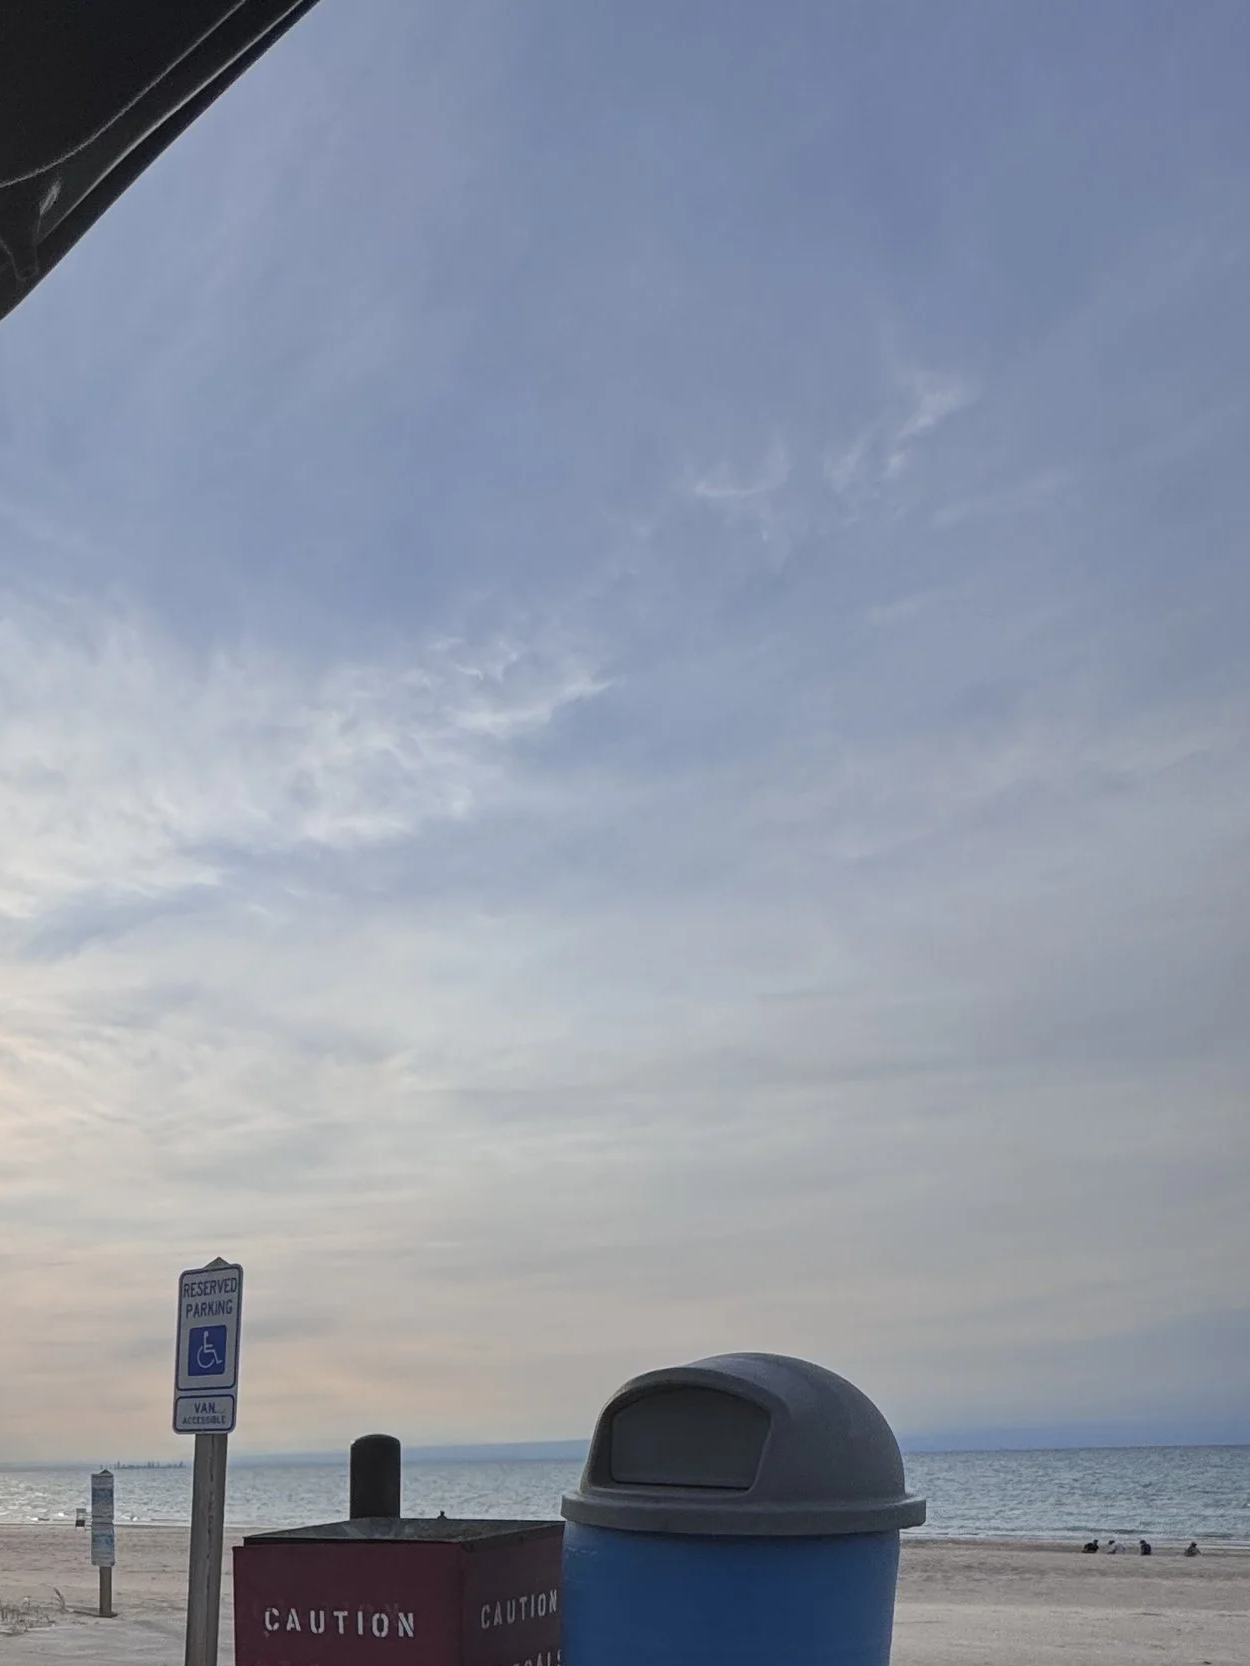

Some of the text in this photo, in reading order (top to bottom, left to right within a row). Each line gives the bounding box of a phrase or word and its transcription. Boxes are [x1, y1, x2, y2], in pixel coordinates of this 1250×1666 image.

[182, 1277, 237, 1298] RESERVED
[185, 1300, 233, 1318] PARKING
[194, 1402, 216, 1414] VAN
[480, 1588, 558, 1629] CAUTION
[264, 1607, 415, 1638] CAUTION
